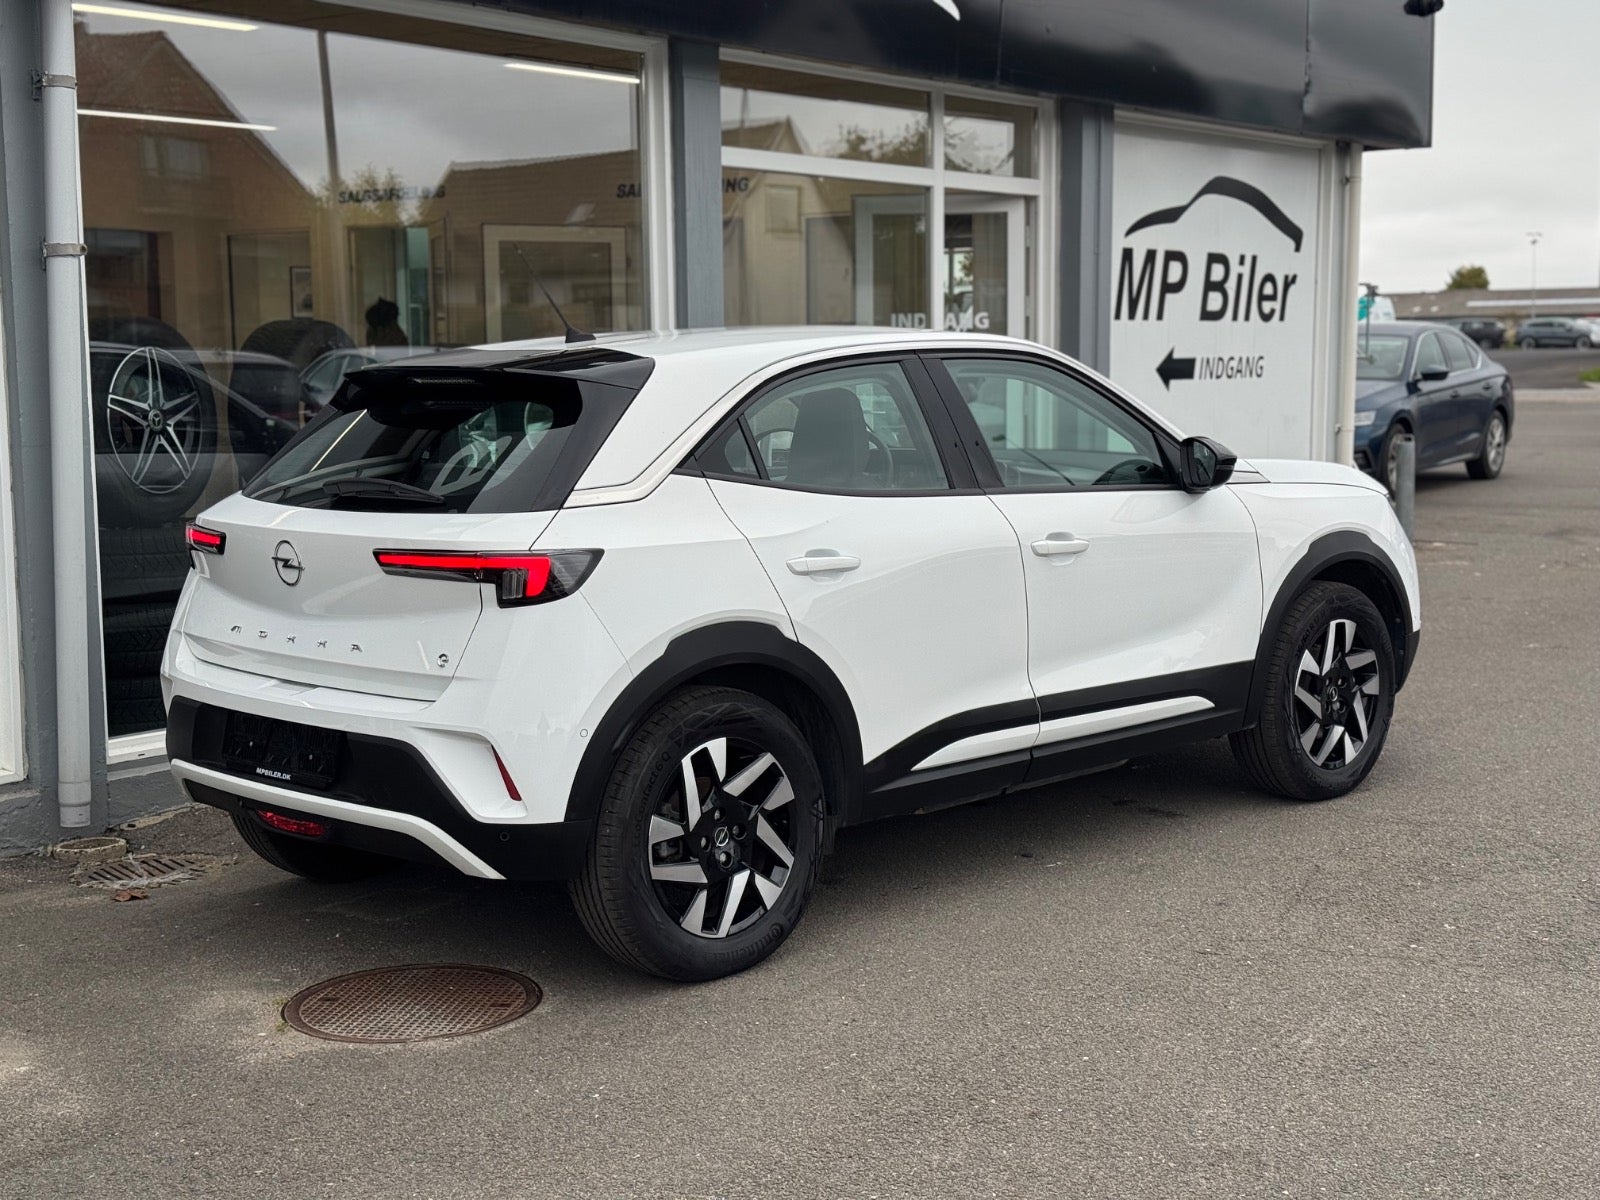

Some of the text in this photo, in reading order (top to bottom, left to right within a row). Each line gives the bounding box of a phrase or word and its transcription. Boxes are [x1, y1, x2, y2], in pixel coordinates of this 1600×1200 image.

[1114, 247, 1298, 323] MP Biler
[1199, 355, 1265, 380] INDGANG
[230, 625, 363, 653] MOKKA
[255, 767, 292, 781] MPBILER.DK
